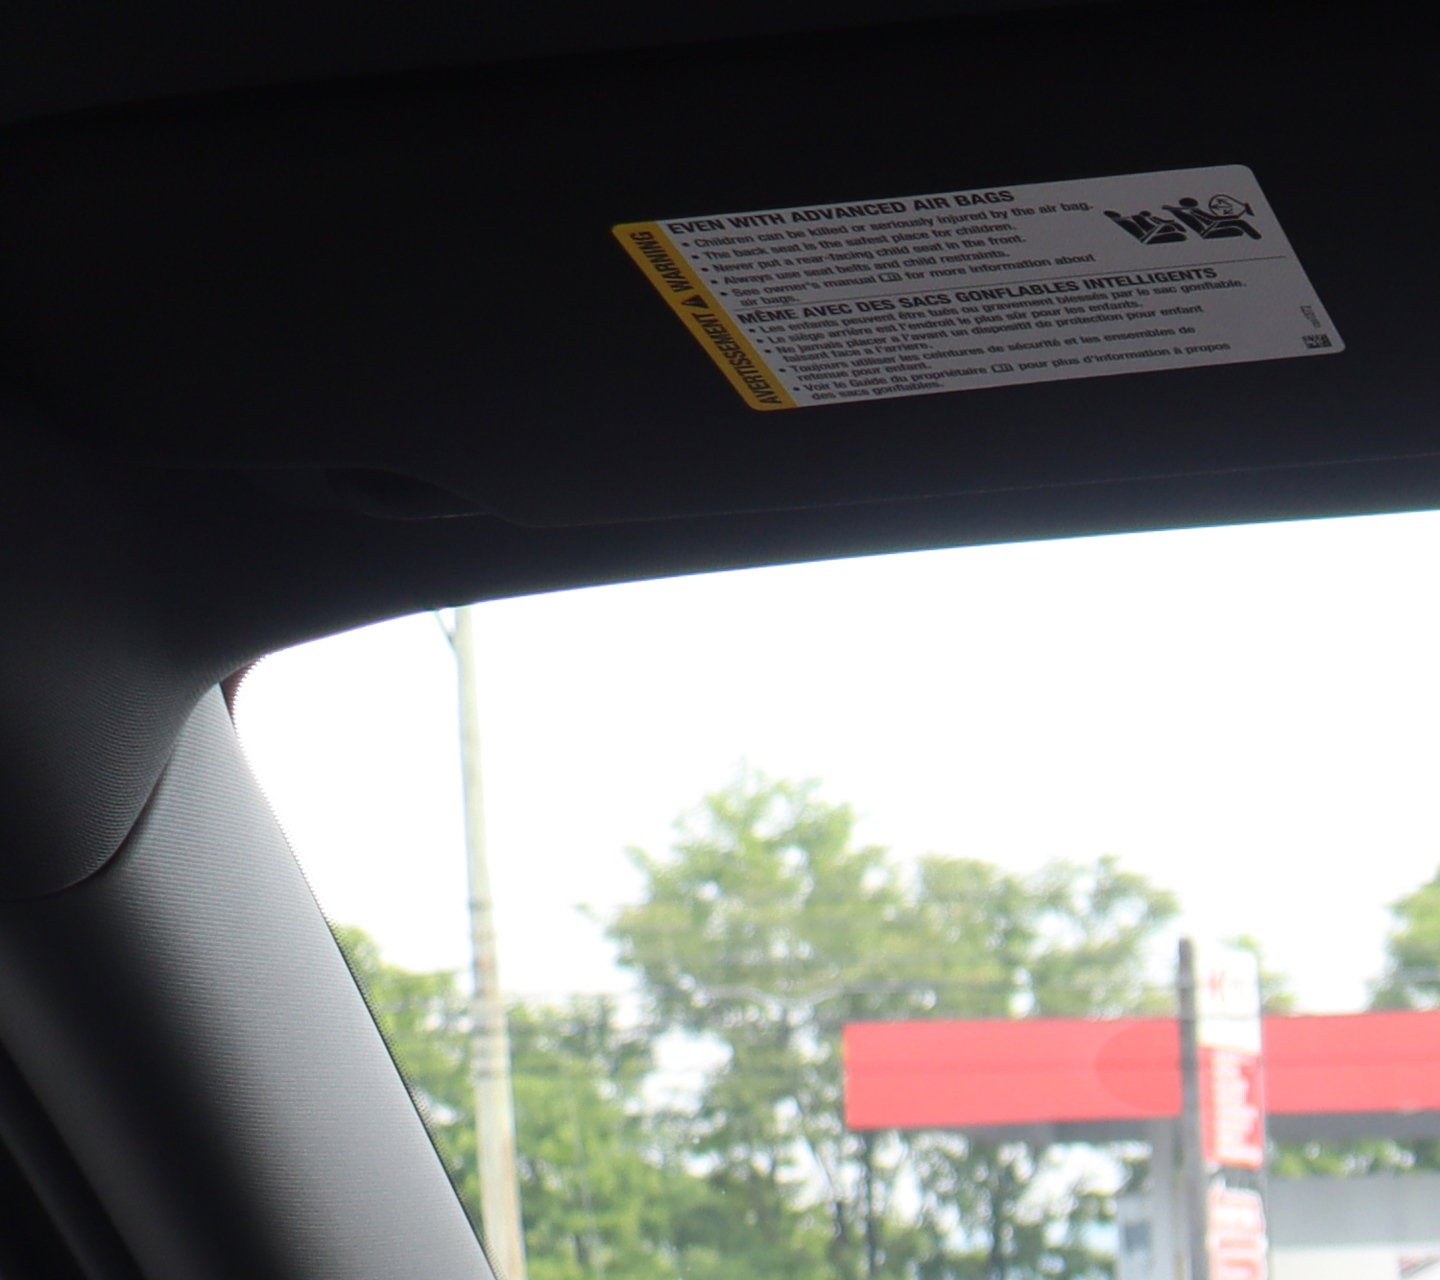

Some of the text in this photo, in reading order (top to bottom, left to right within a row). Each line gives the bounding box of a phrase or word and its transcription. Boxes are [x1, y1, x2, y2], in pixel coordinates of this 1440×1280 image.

[664, 190, 1016, 234] EVEN WITH ADVANCED AIR BAGS
[691, 200, 1095, 247] Children can be killed or seriously injured by the air bag.
[627, 230, 696, 292] WARNING
[702, 221, 1019, 259] The back seat is the safest place for children.
[710, 260, 756, 272] Never
[754, 258, 784, 270] put
[792, 248, 876, 266] rear-facing
[872, 245, 911, 256] child
[909, 241, 944, 252] seat
[942, 240, 961, 249] in
[959, 237, 987, 247] the
[985, 233, 1026, 245] front.
[719, 248, 1010, 286] Always use seat belts and child restraints.
[729, 252, 1096, 296] See owner's manual for more information about
[733, 267, 1218, 323] MÊME AVEC DES SACS GONFLABLES INTELLIGENTS
[691, 311, 783, 405] AVERTISSEMENT
